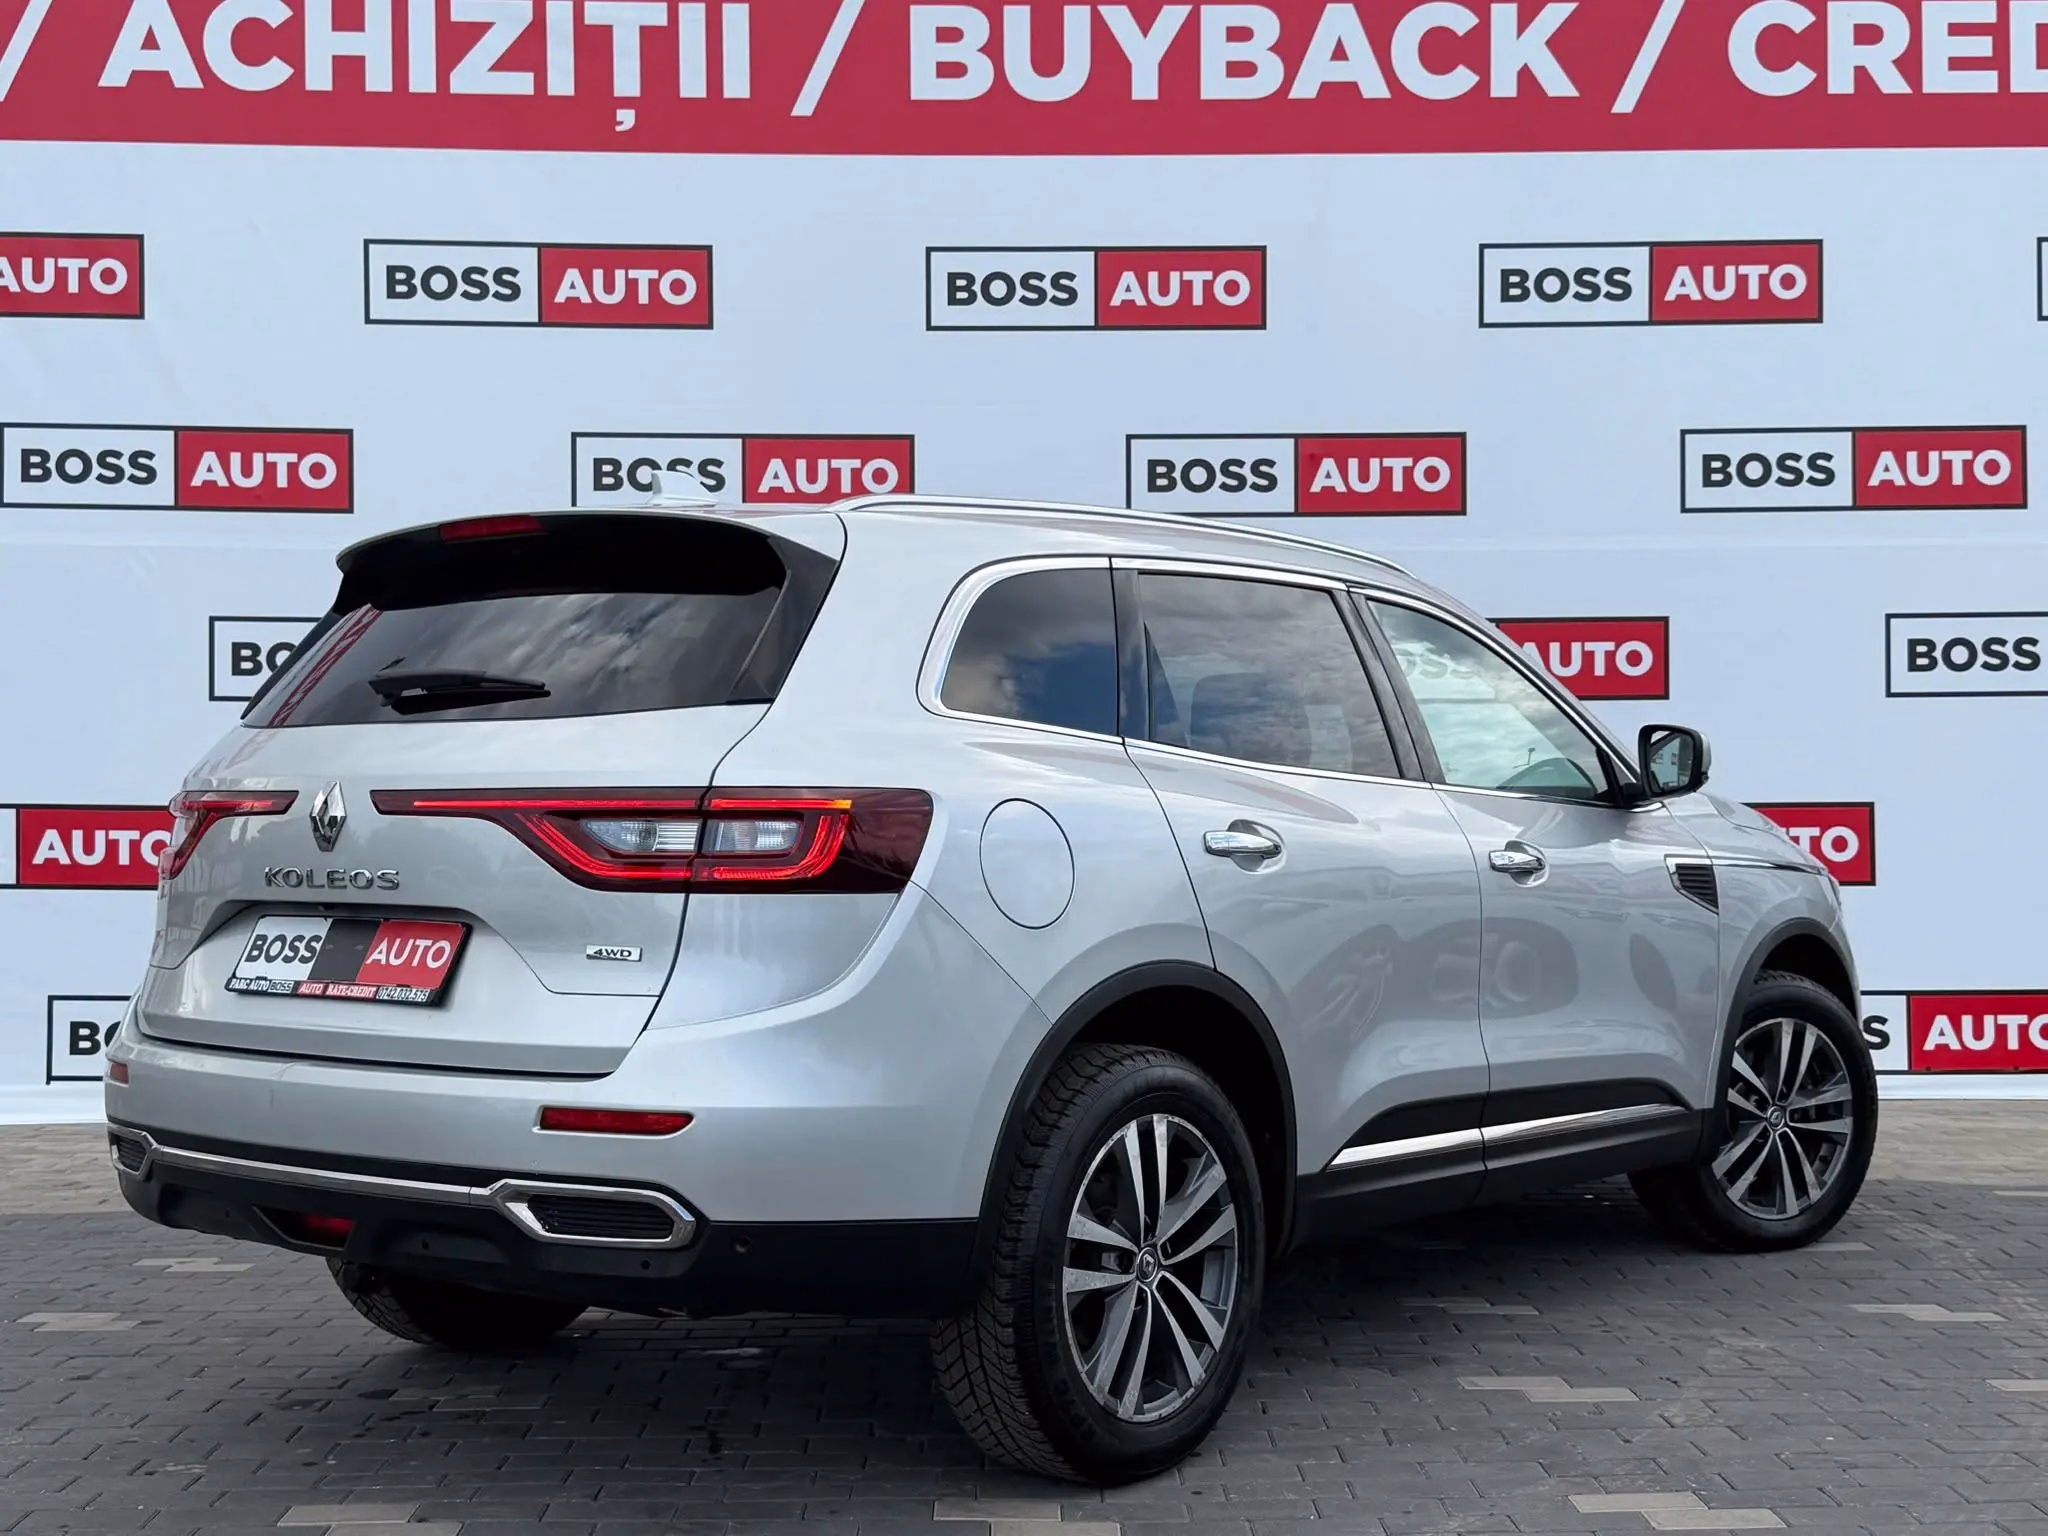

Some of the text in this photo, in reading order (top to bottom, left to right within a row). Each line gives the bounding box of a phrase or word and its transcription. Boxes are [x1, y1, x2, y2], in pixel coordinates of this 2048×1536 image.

[98, 0, 750, 131] ACHIZIȚII
[909, 1, 1580, 102] BUYBACK
[386, 264, 697, 306] BOSS AUTO
[947, 269, 1251, 307] BOSS AUTO
[1500, 263, 1807, 303] BOSS AUTO
[20, 448, 338, 490] BOSS AUTO
[757, 458, 899, 494] AUTO
[1147, 456, 1451, 494] BOSS AUTO
[1702, 449, 2012, 488] BOSS AUTO
[1907, 636, 2041, 673] BOSS
[32, 828, 172, 867] AUTO
[264, 866, 400, 891] KOLEOS
[243, 933, 452, 969] BOSS AUTO
[593, 948, 632, 958] 4WD
[229, 977, 250, 990] PARC
[248, 979, 270, 992] AUTO
[269, 980, 293, 993] BOSS
[298, 982, 324, 995] AUTO
